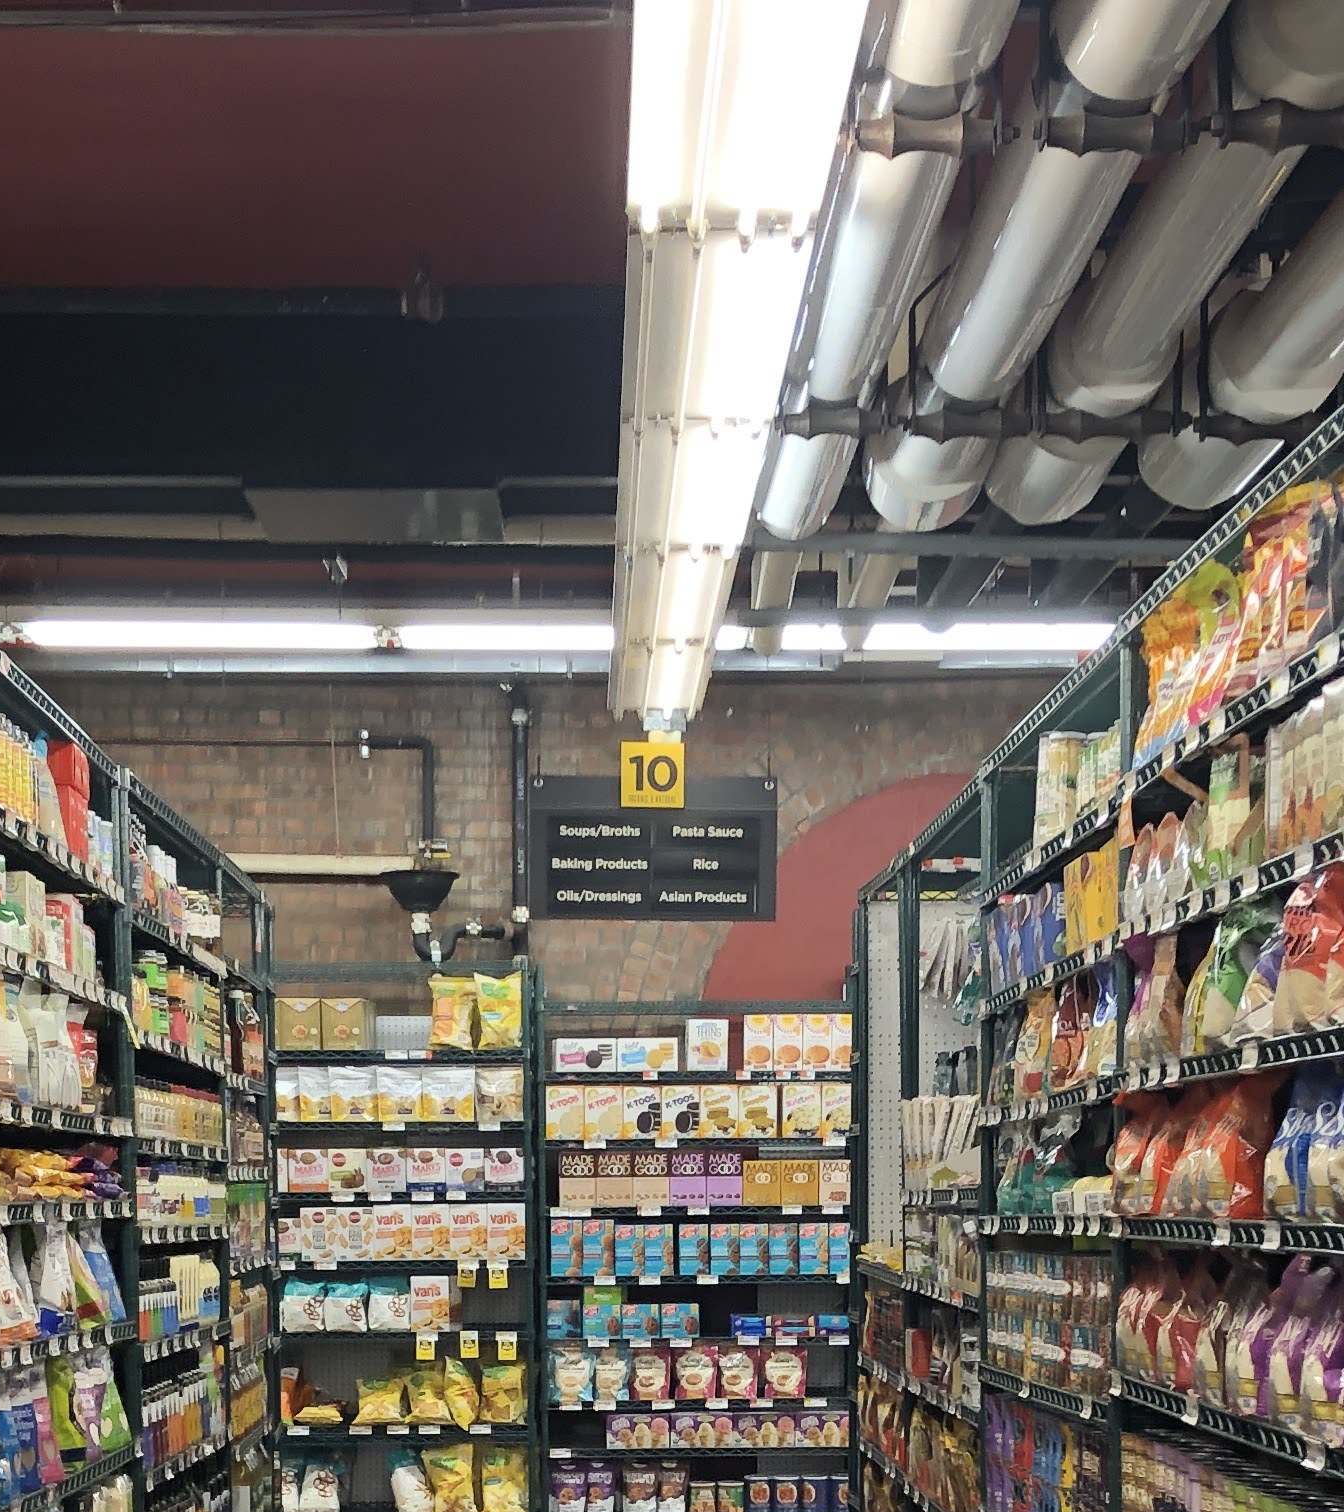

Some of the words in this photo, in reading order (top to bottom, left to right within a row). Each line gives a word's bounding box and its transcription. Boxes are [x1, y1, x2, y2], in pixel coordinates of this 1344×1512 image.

[629, 755, 677, 792] 10
[559, 824, 641, 839] Soups/Broths
[672, 825, 704, 838] Pasta
[707, 825, 743, 838] Sauce
[551, 857, 592, 872] Baking
[595, 857, 648, 871] Products
[693, 858, 719, 871] Rice
[556, 890, 642, 904] Oils/Dressings
[659, 890, 692, 904] Asian
[694, 891, 748, 904] Products
[561, 1154, 594, 1165] MADE
[597, 1154, 631, 1165] MADE
[634, 1153, 668, 1165] MADE
[671, 1153, 704, 1164] MADE
[709, 1153, 741, 1164] MADE
[561, 1165, 595, 1176] GOOD
[597, 1165, 631, 1176] GOOD
[635, 1164, 668, 1176] GOOD
[671, 1164, 705, 1175] GOOD
[709, 1163, 742, 1175] GOOD
[746, 1162, 778, 1173] MADE
[783, 1163, 815, 1173] MADE
[746, 1172, 778, 1184] GOOD
[783, 1172, 816, 1184] GOOD
[376, 1212, 405, 1226] van's
[414, 1212, 442, 1226] van's
[451, 1212, 480, 1226] van's
[489, 1212, 518, 1225] van's
[413, 1285, 442, 1299] van's
